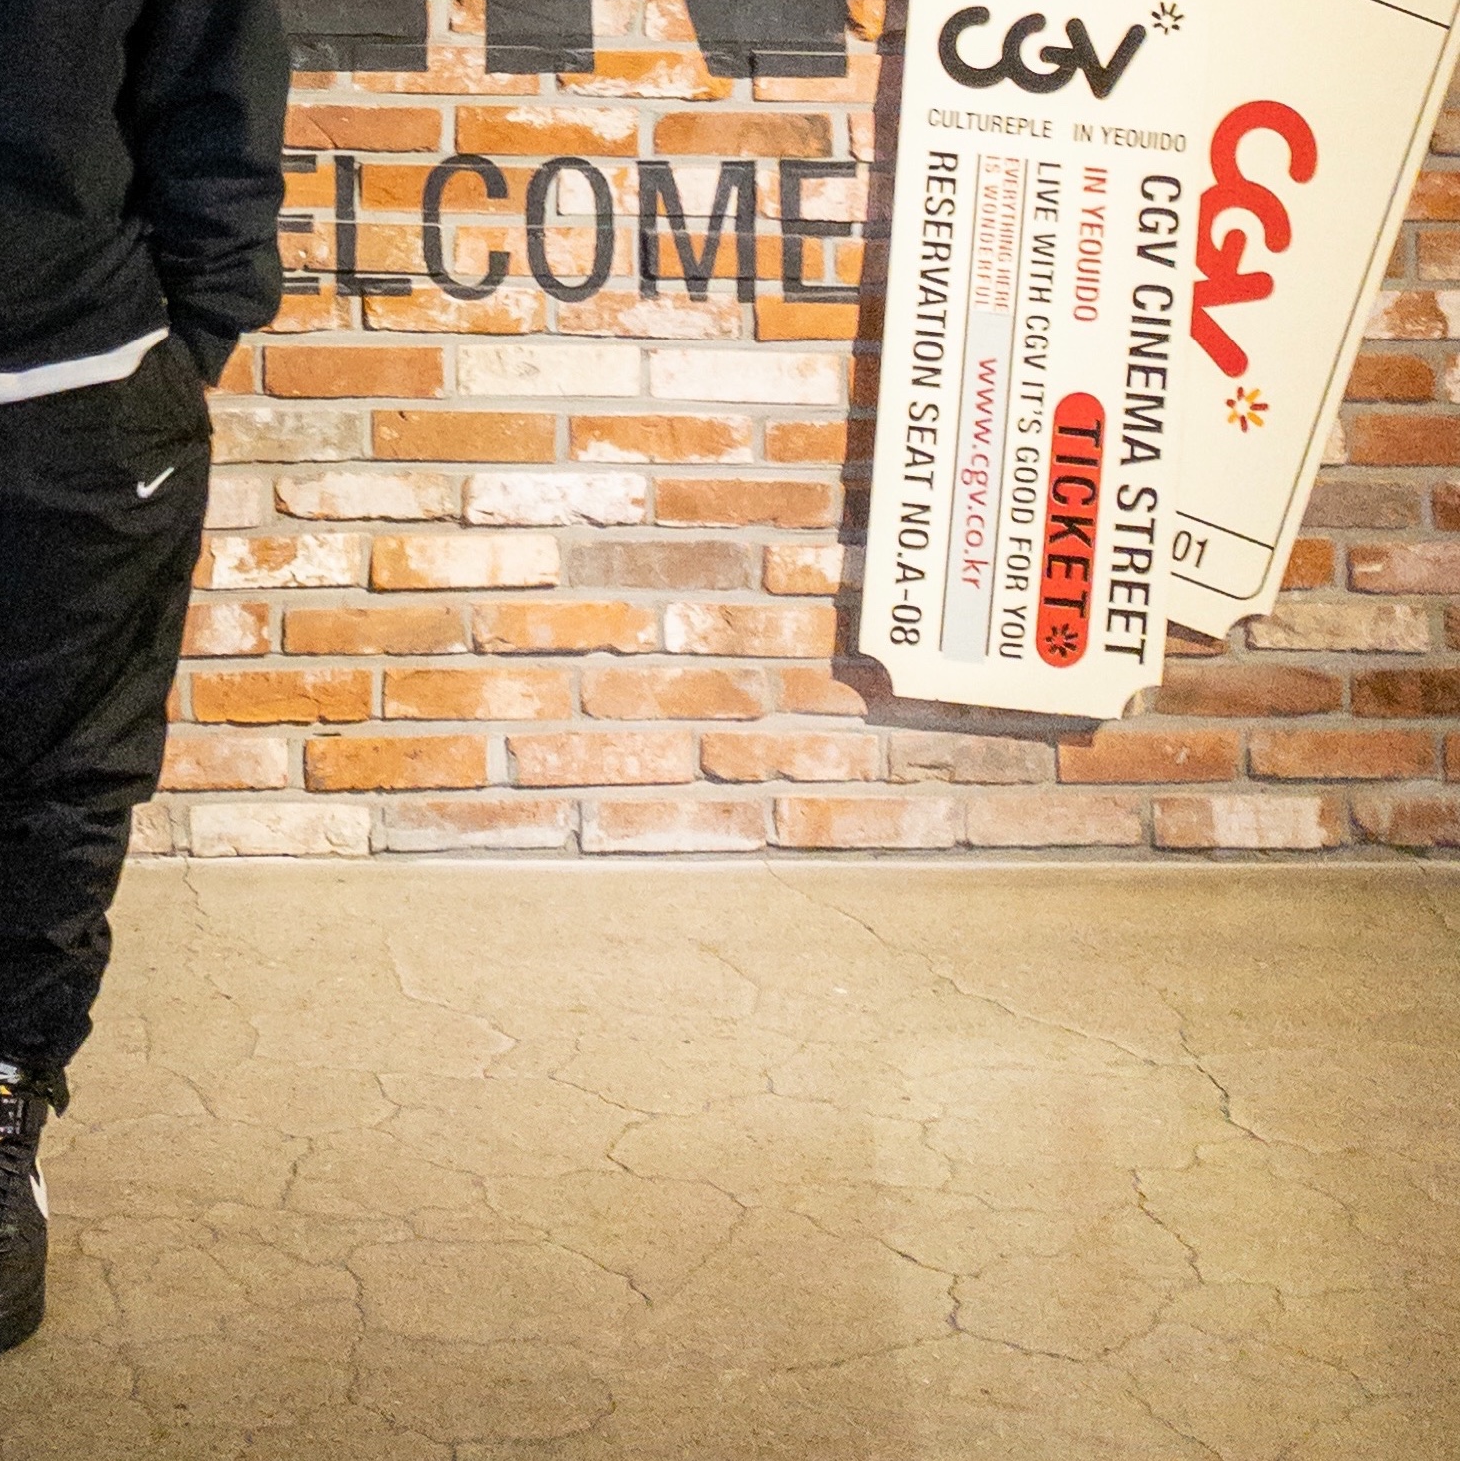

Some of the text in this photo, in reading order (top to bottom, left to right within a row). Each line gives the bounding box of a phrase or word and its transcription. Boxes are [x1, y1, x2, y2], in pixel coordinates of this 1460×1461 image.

[928, 107, 1188, 153] CULTUREPLE IN YEOUIDO
[938, 5, 1147, 100] CGV
[974, 154, 1001, 310] IS WONDERFUL
[994, 156, 1020, 313] EVERYTHING HERE
[1072, 165, 1108, 323] IN YEOUIDO
[1190, 99, 1318, 378] CGV
[890, 150, 959, 647] RESERVATION SEAT NO.A-08
[960, 357, 998, 590] www.cgv.co.kr
[999, 160, 1063, 661] LIVE WITH CGV IT'S GOOD FOR YOU
[1103, 173, 1183, 666] CGV CINEMA STREET
[1041, 418, 1104, 620] TICKET
